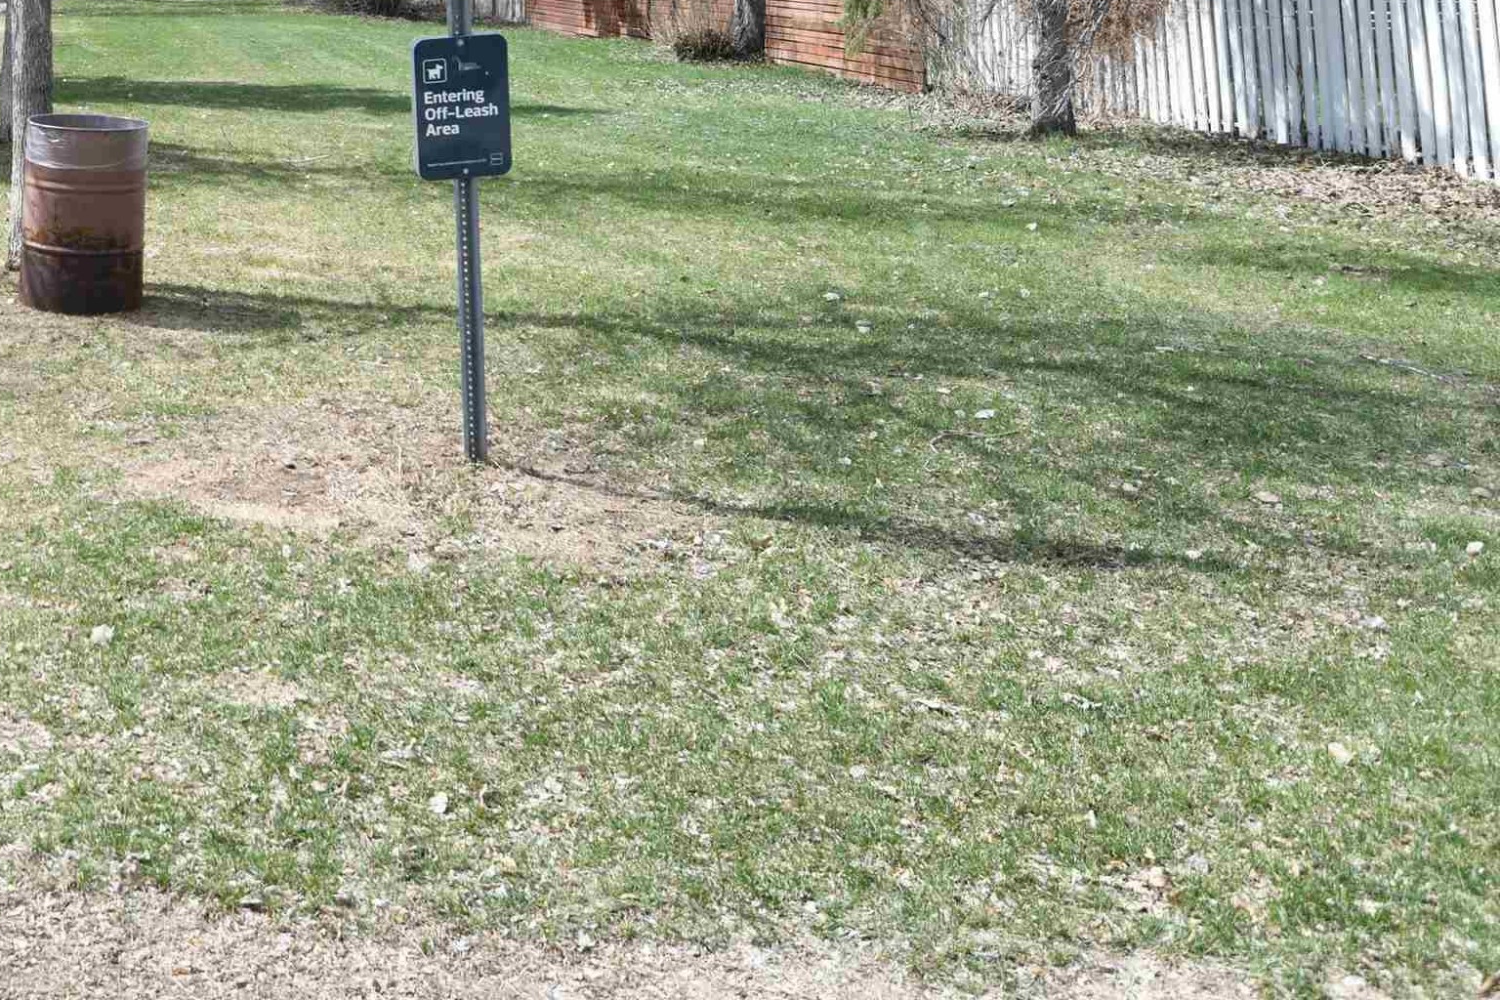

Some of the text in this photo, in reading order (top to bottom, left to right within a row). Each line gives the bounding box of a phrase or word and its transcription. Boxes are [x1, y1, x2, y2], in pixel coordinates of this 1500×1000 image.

[424, 89, 485, 104] Entering
[425, 103, 499, 121] Off-Leash
[426, 124, 460, 137] Area
